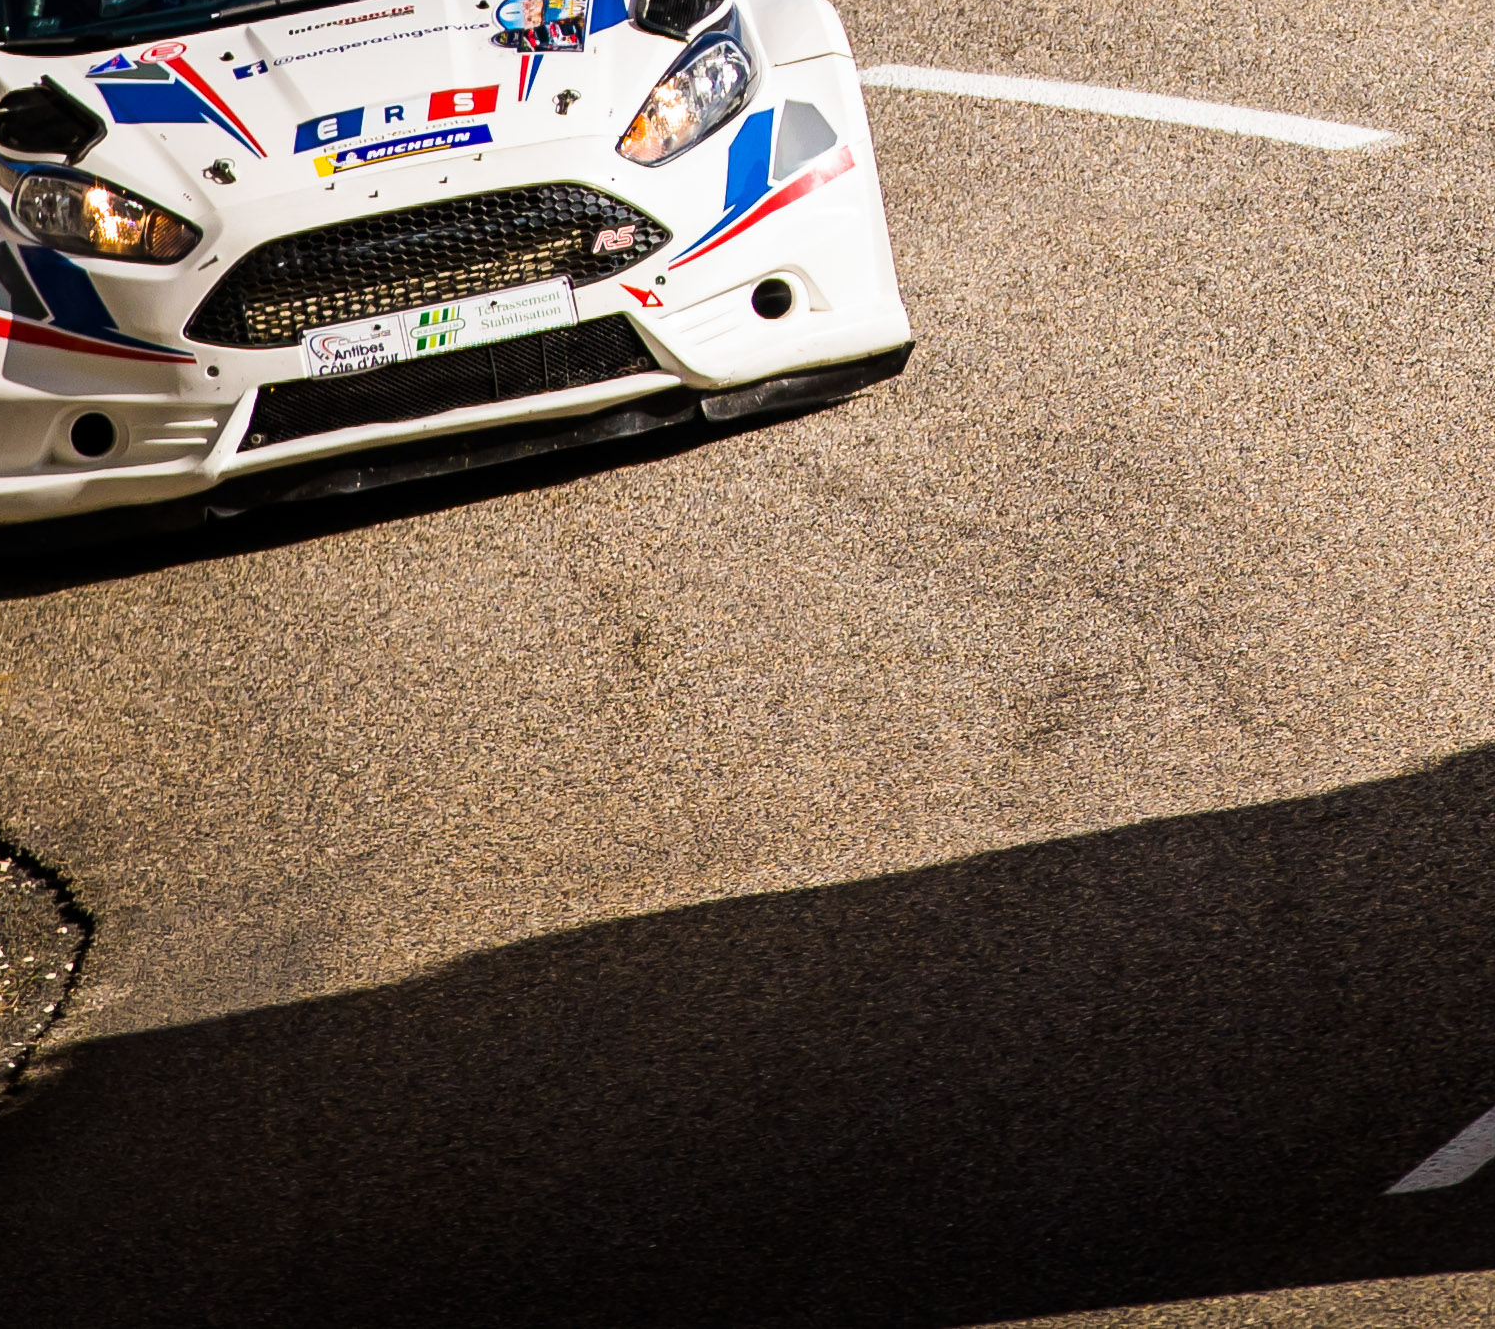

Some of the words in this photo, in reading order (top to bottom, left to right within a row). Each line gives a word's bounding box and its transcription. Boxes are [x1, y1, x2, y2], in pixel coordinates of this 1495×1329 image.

[273, 21, 490, 67] @europeracingservice
[366, 132, 471, 160] MICHELIN
[475, 291, 561, 318] Terrassement
[480, 306, 562, 331] Stabilisation
[319, 360, 353, 377] Côte
[358, 352, 398, 369] d'Azur
[334, 342, 385, 361] Antibes
